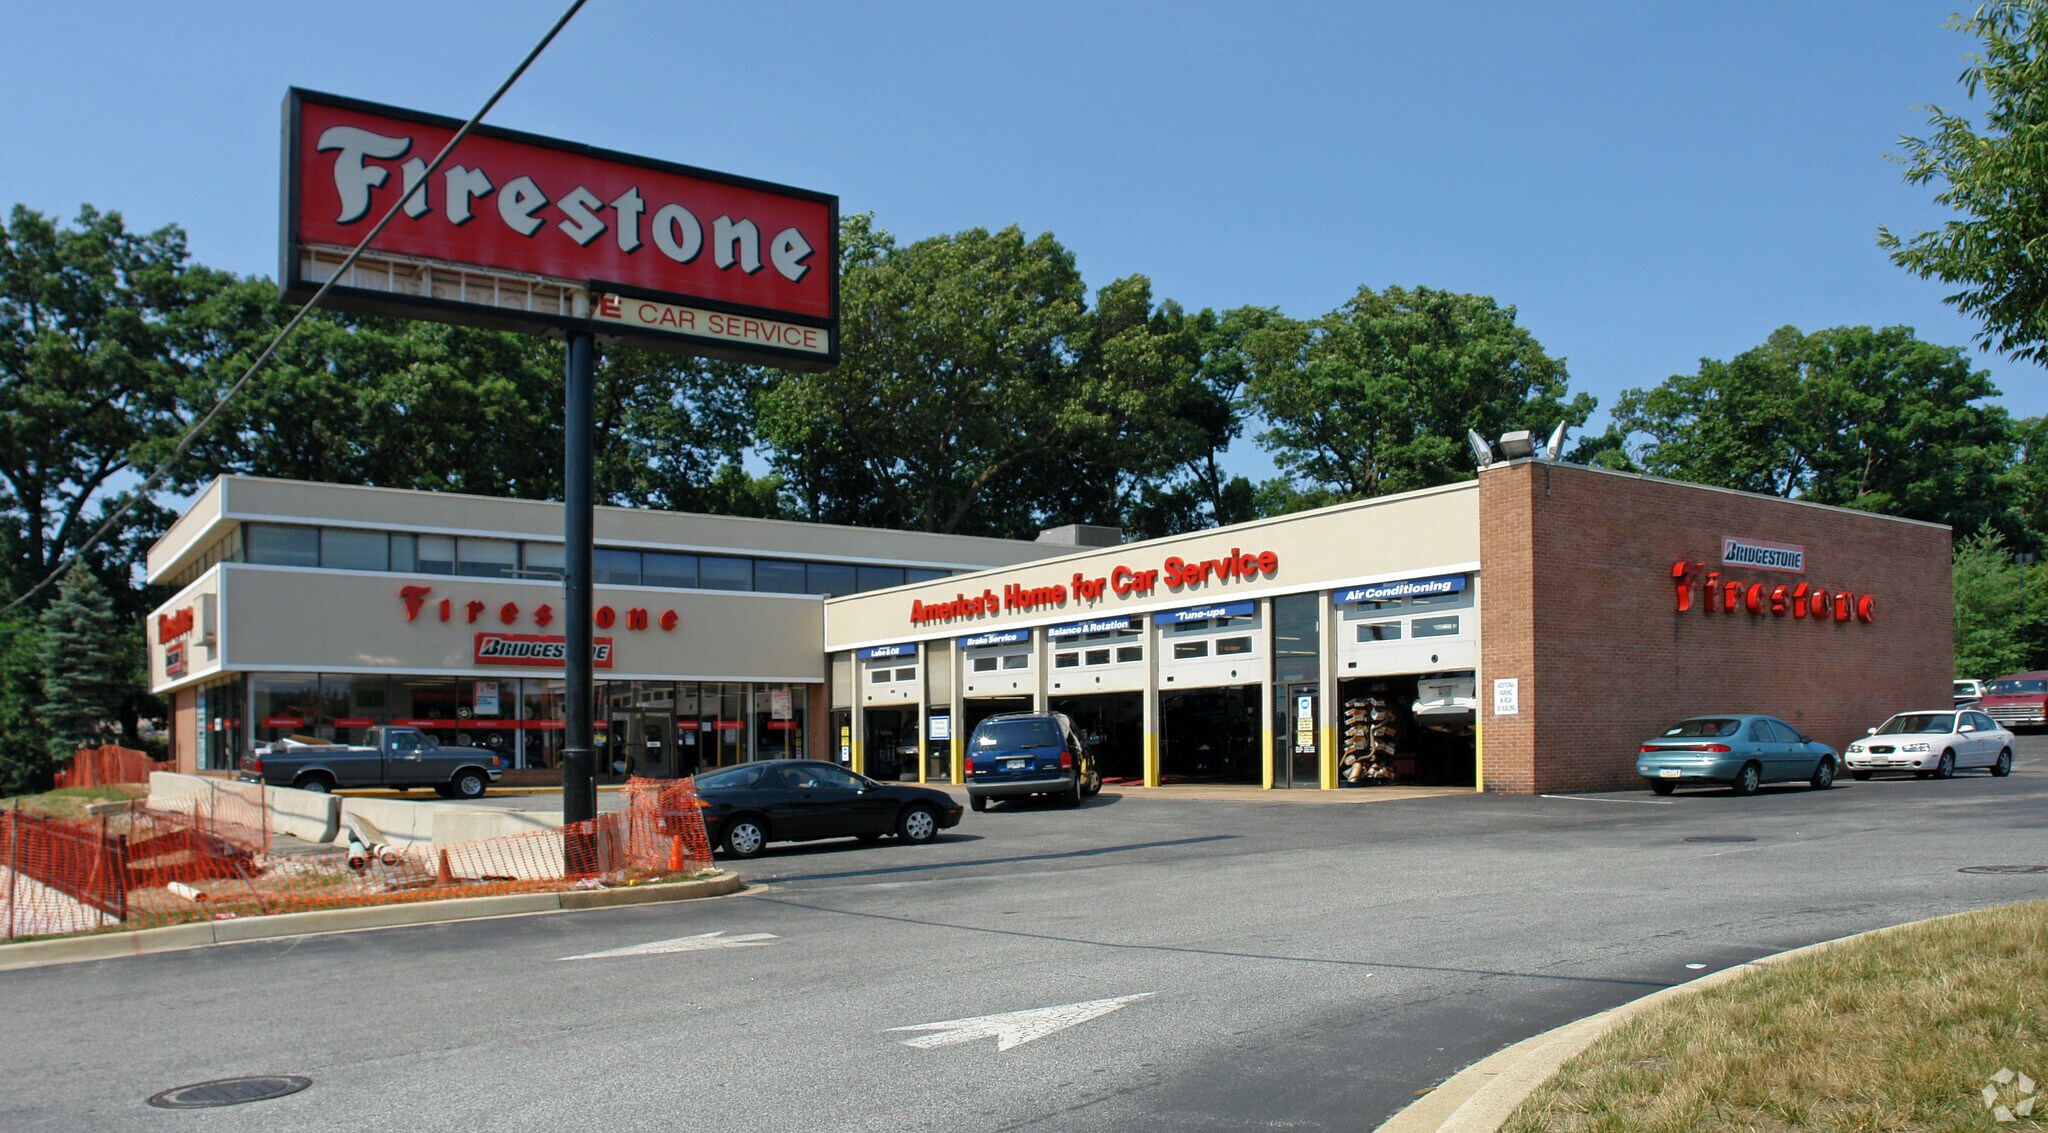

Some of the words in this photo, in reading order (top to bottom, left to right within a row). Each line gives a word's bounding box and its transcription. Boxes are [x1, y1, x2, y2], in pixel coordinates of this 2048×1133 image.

[316, 124, 816, 284] Firestone
[638, 303, 696, 330] CAR
[708, 314, 818, 349] SERVICE
[1725, 541, 1801, 569] BRIDGESTONE
[910, 588, 1000, 624] America's
[1004, 583, 1067, 610] Home
[1071, 572, 1107, 601] for
[1111, 565, 1159, 596] Car
[1163, 547, 1278, 588] Service
[1345, 591, 1366, 601] Air
[1365, 581, 1452, 599] Conditioning
[1671, 561, 1876, 624] Firestone
[399, 585, 679, 632] Firesone
[967, 637, 988, 646] Brake
[988, 633, 1017, 643] Service
[1048, 625, 1081, 637] Balance
[1082, 624, 1089, 633] &
[1090, 620, 1129, 632] Rotation
[479, 638, 609, 660] BRIDGESE
